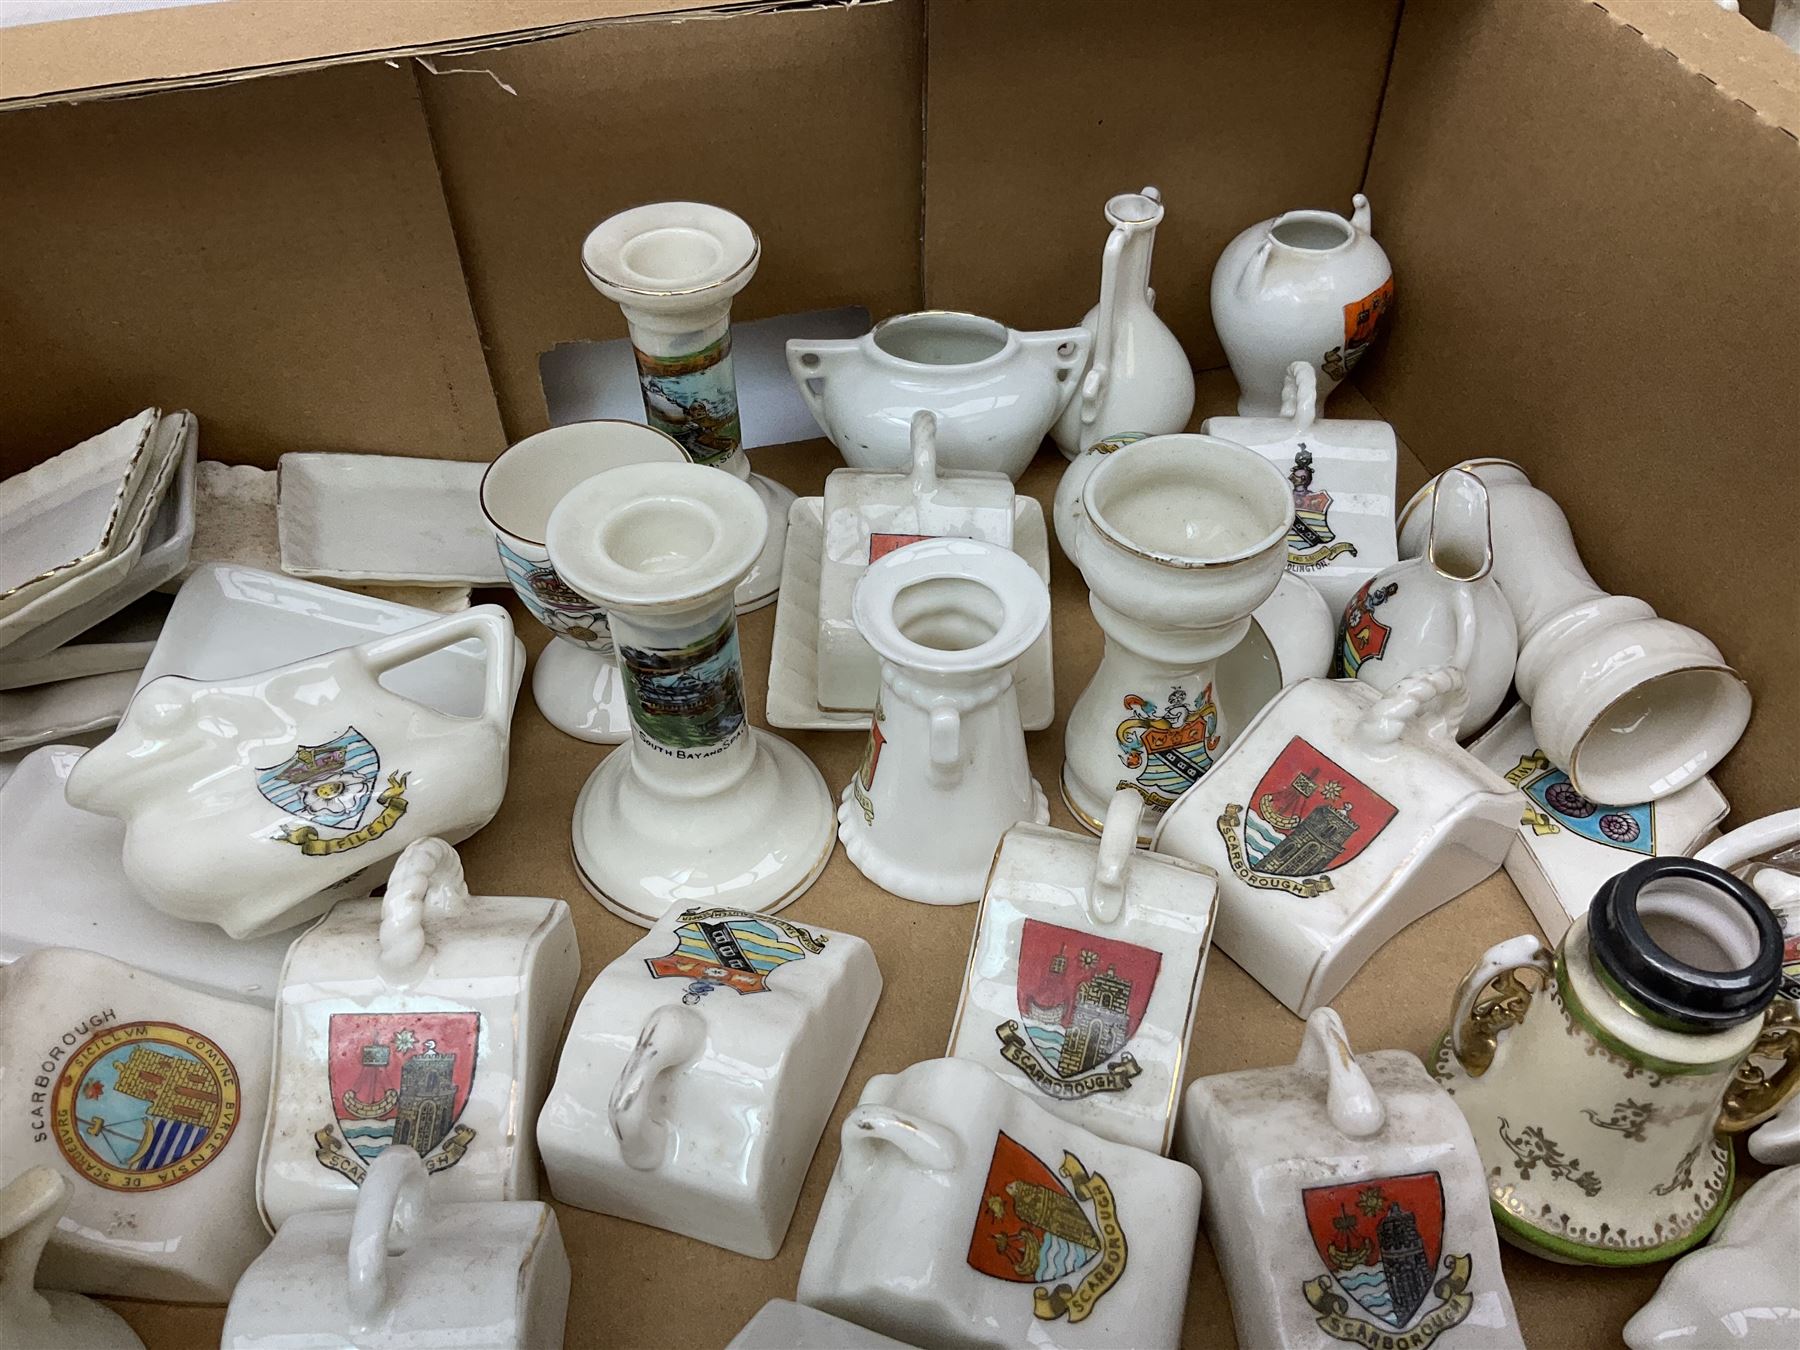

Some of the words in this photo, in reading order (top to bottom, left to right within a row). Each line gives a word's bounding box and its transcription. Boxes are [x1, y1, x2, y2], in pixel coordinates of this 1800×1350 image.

[639, 731, 673, 757] SOUTH
[676, 750, 703, 760] BAY
[337, 815, 390, 849] FILEY
[1222, 826, 1303, 893] SCARBOROUGH
[31, 1008, 117, 1143] SCARBOROUGH
[185, 1036, 235, 1087] COMVNE
[1011, 1053, 1117, 1095] SCARBOROUGH
[122, 1175, 141, 1187] DE
[1071, 1185, 1122, 1313] SCARBOROUGH
[1329, 1299, 1463, 1350] SCARBOROUGH
